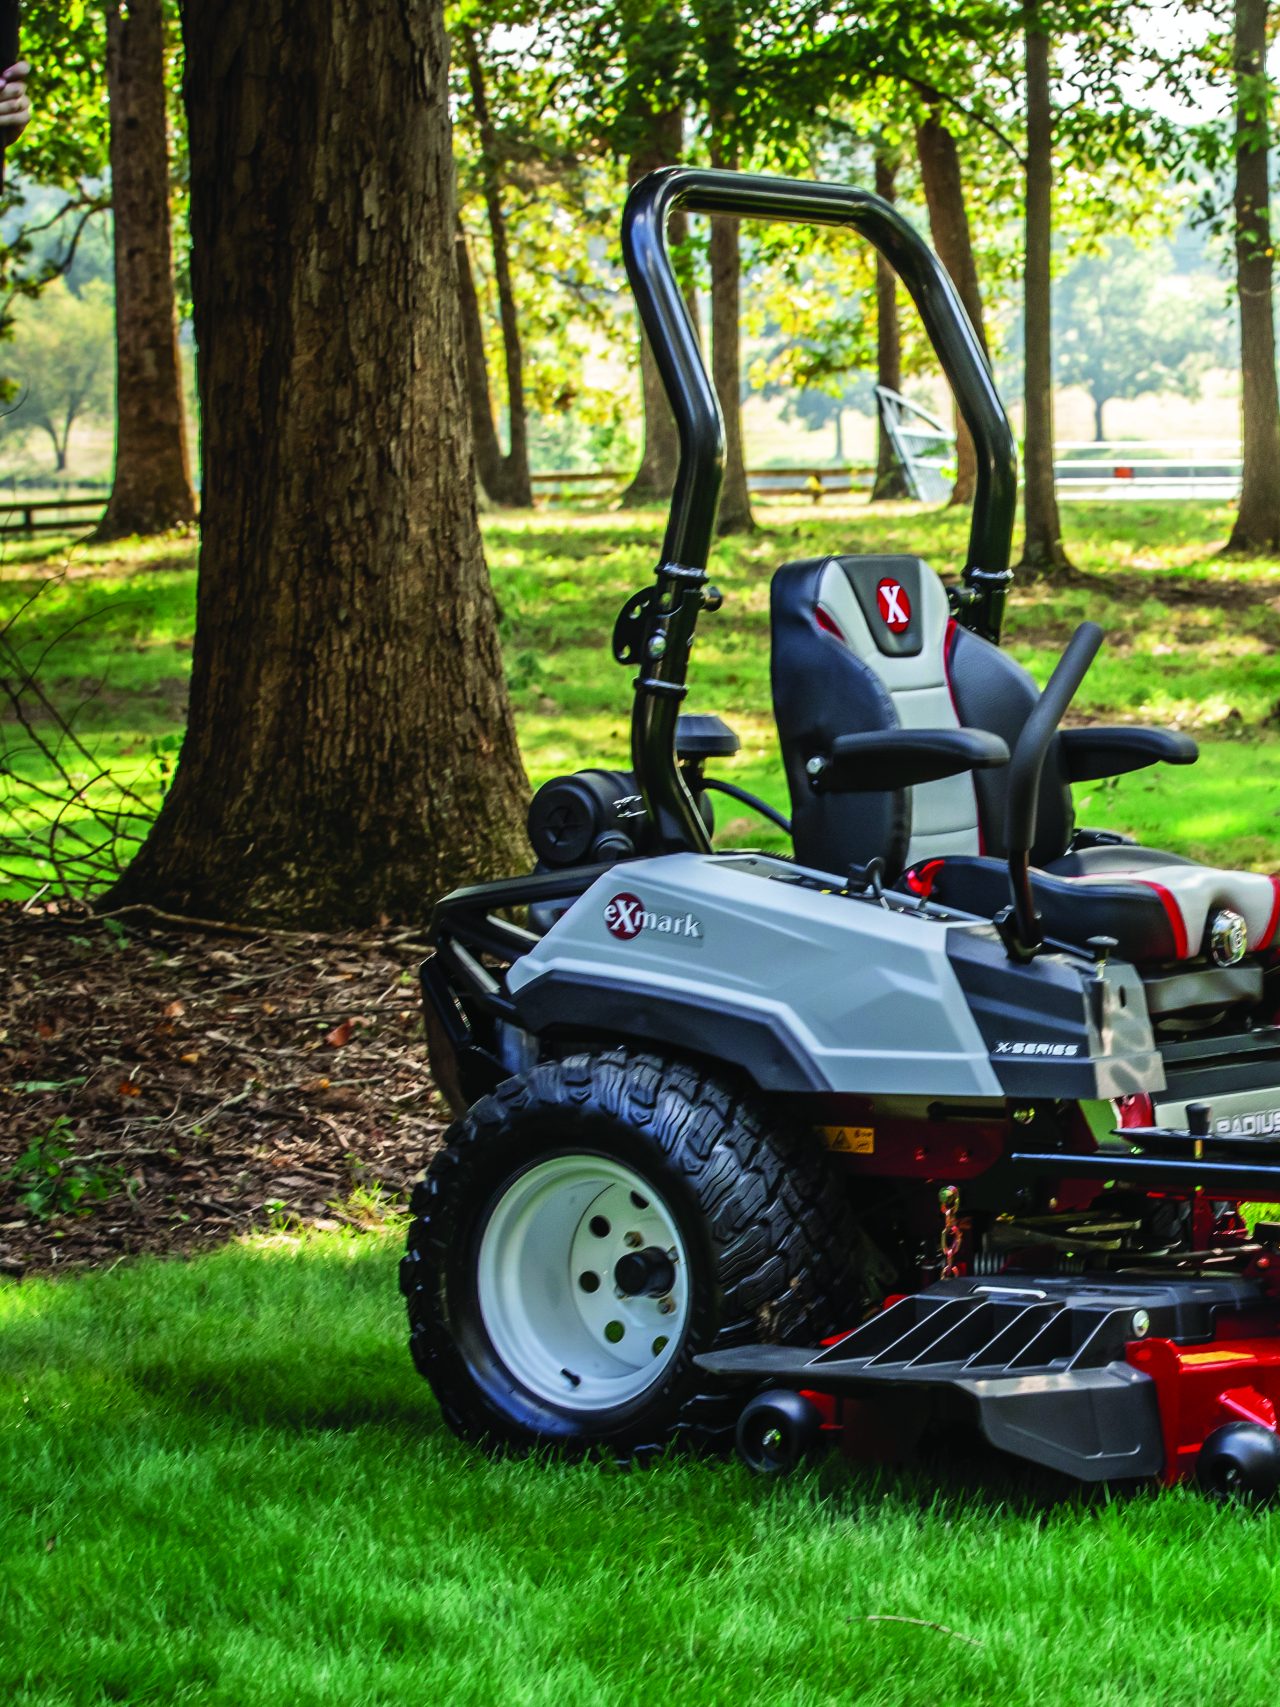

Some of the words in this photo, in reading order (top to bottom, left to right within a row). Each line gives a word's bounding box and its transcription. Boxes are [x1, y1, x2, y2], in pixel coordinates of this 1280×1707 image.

[879, 585, 909, 624] X
[603, 899, 701, 938] eXmark
[995, 1042, 1079, 1056] X-SERIES
